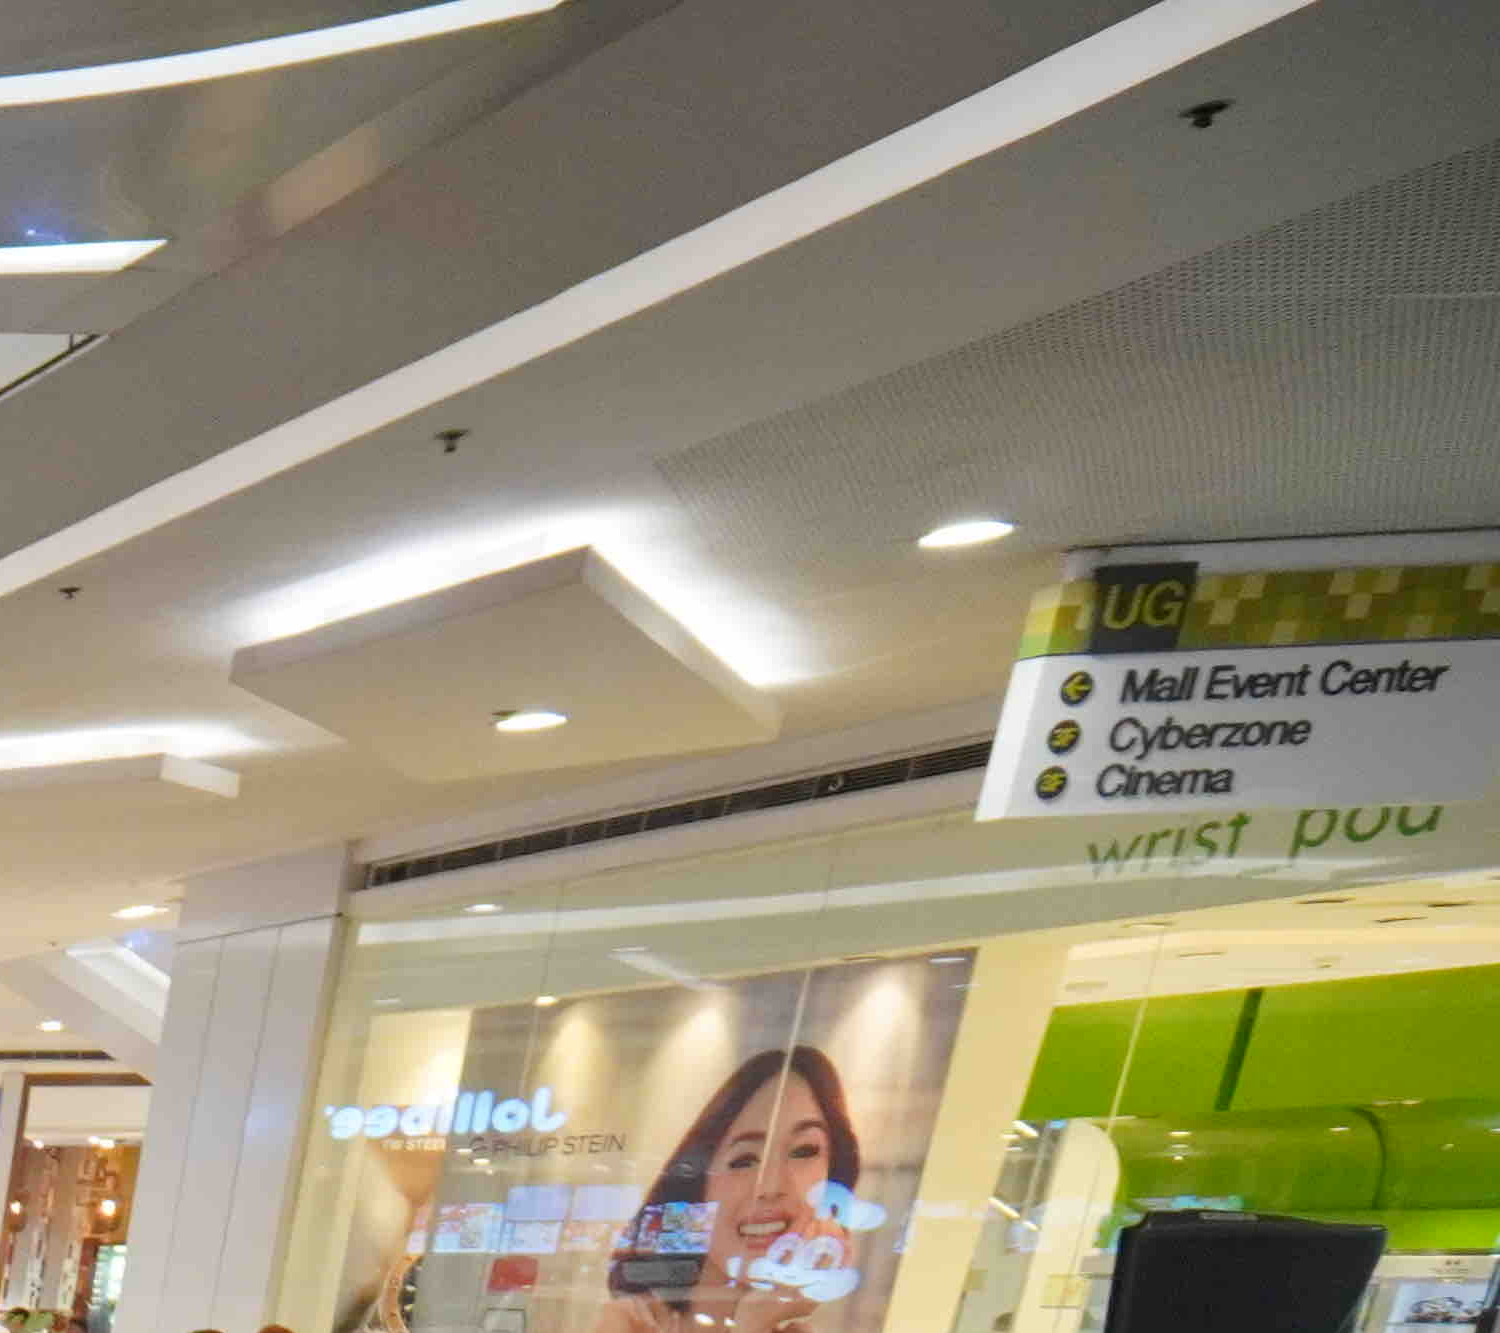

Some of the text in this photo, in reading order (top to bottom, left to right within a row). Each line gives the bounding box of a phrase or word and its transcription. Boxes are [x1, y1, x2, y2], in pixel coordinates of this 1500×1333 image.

[1102, 581, 1185, 630] UG
[1119, 660, 1451, 704] Mall Event Center
[1108, 716, 1312, 761] Cyberzone
[1095, 763, 1236, 799] Cinema
[1086, 812, 1251, 880] wrist
